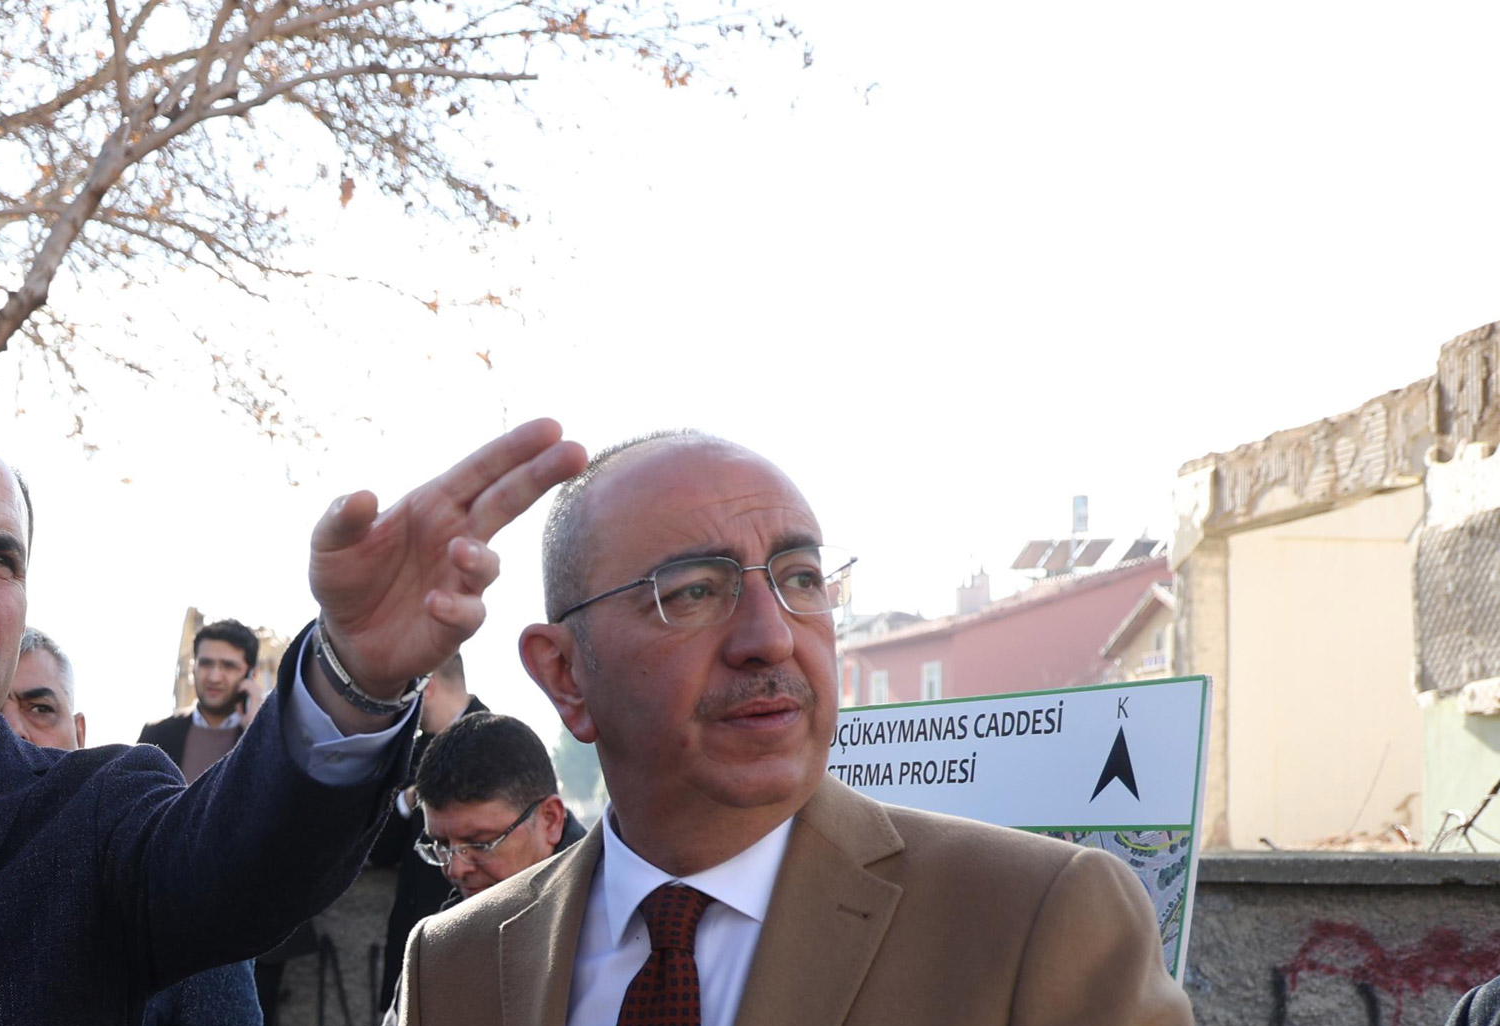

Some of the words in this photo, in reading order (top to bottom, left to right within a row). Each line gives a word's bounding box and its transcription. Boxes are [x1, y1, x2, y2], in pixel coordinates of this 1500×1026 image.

[973, 700, 1064, 739] CADDESİ
[1117, 697, 1130, 720] K
[899, 751, 977, 787] PROJESİ
